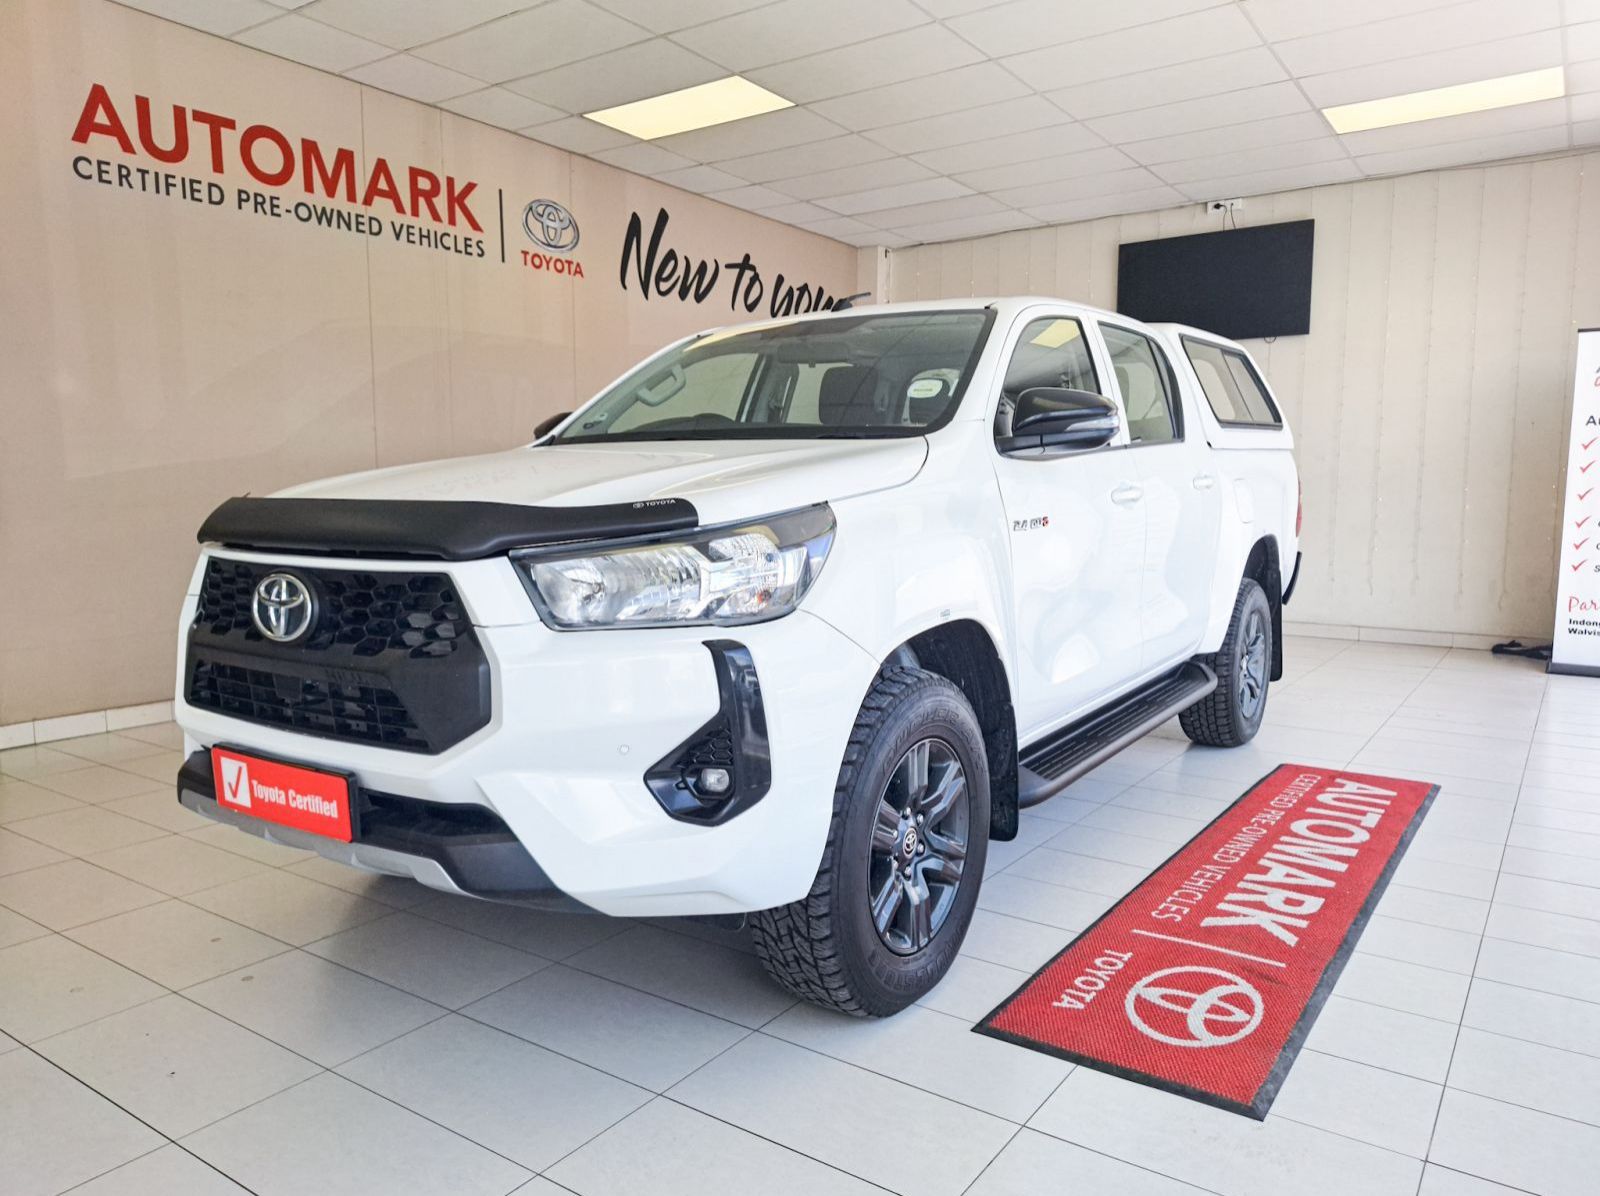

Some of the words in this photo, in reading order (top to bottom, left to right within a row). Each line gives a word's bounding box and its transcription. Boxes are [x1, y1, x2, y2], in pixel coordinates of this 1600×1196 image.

[71, 83, 484, 233] AUTOMARK
[72, 155, 225, 206] CERTIFIED
[237, 188, 383, 237] PRE-OWNED
[390, 220, 486, 258] VEHICLES
[520, 250, 584, 279] TOYOTA
[620, 207, 720, 304] New
[724, 253, 764, 313] to
[645, 499, 676, 507] TOYOTA
[251, 779, 286, 805] Toyota
[288, 788, 338, 819] Certified
[1269, 773, 1322, 809] CERTIFIED
[1200, 778, 1397, 948] AUTOMARK
[1213, 808, 1286, 864] PRE-OWNED
[1151, 864, 1231, 923] VEHICLES
[1052, 949, 1134, 1010] TOYOTA
